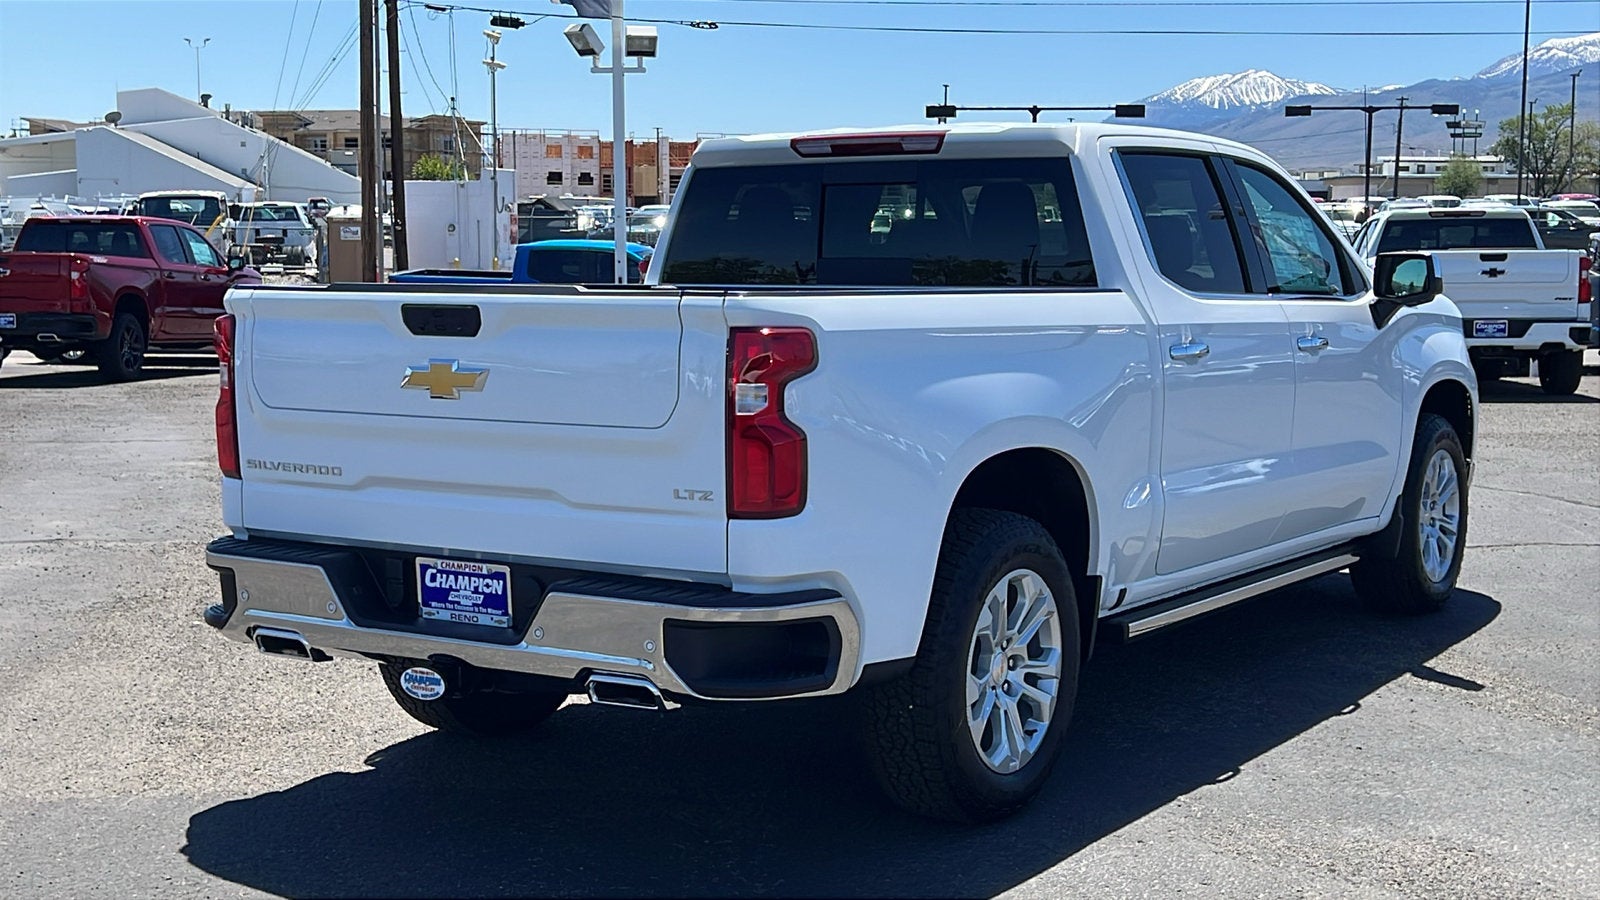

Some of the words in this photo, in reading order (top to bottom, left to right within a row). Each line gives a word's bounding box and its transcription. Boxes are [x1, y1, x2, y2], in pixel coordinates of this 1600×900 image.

[246, 459, 342, 476] SILVERADO
[673, 488, 714, 501] LTZ
[440, 561, 483, 573] CHAMPION
[425, 568, 503, 595] CHAMPION
[450, 593, 482, 603] CHEVROLET
[450, 613, 479, 623] RENO
